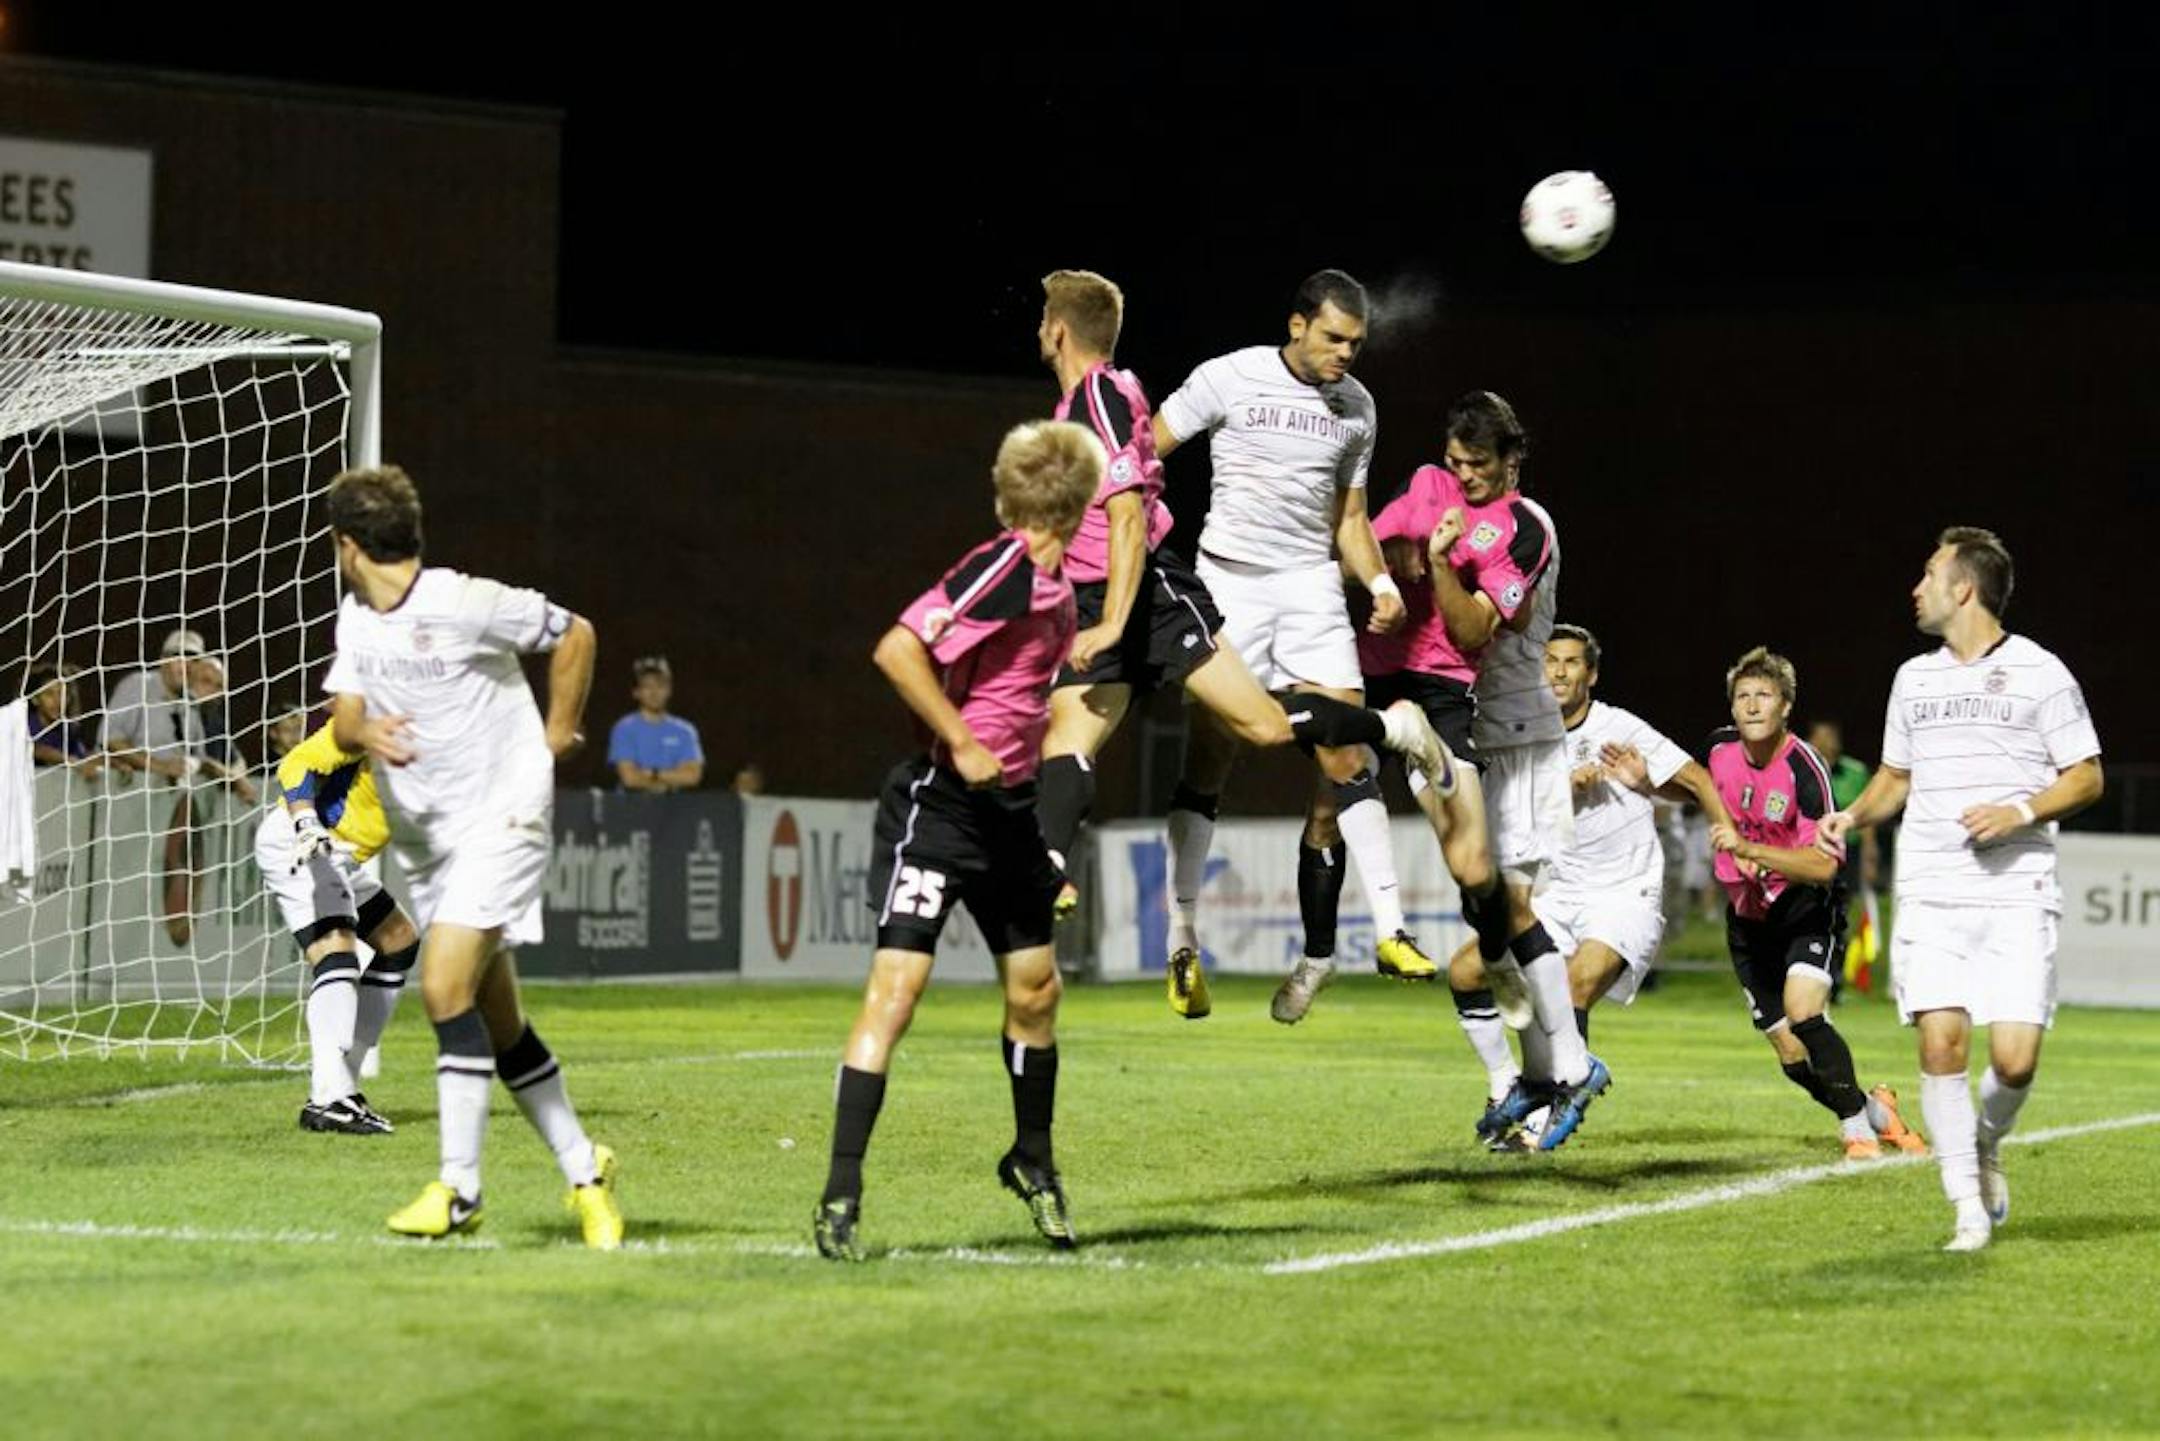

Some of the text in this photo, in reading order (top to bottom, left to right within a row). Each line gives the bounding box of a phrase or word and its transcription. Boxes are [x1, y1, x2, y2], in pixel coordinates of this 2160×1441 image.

[1245, 406, 1279, 427] SAN
[1912, 697, 2012, 724] SAN ANTONIO
[891, 864, 947, 920] 25
